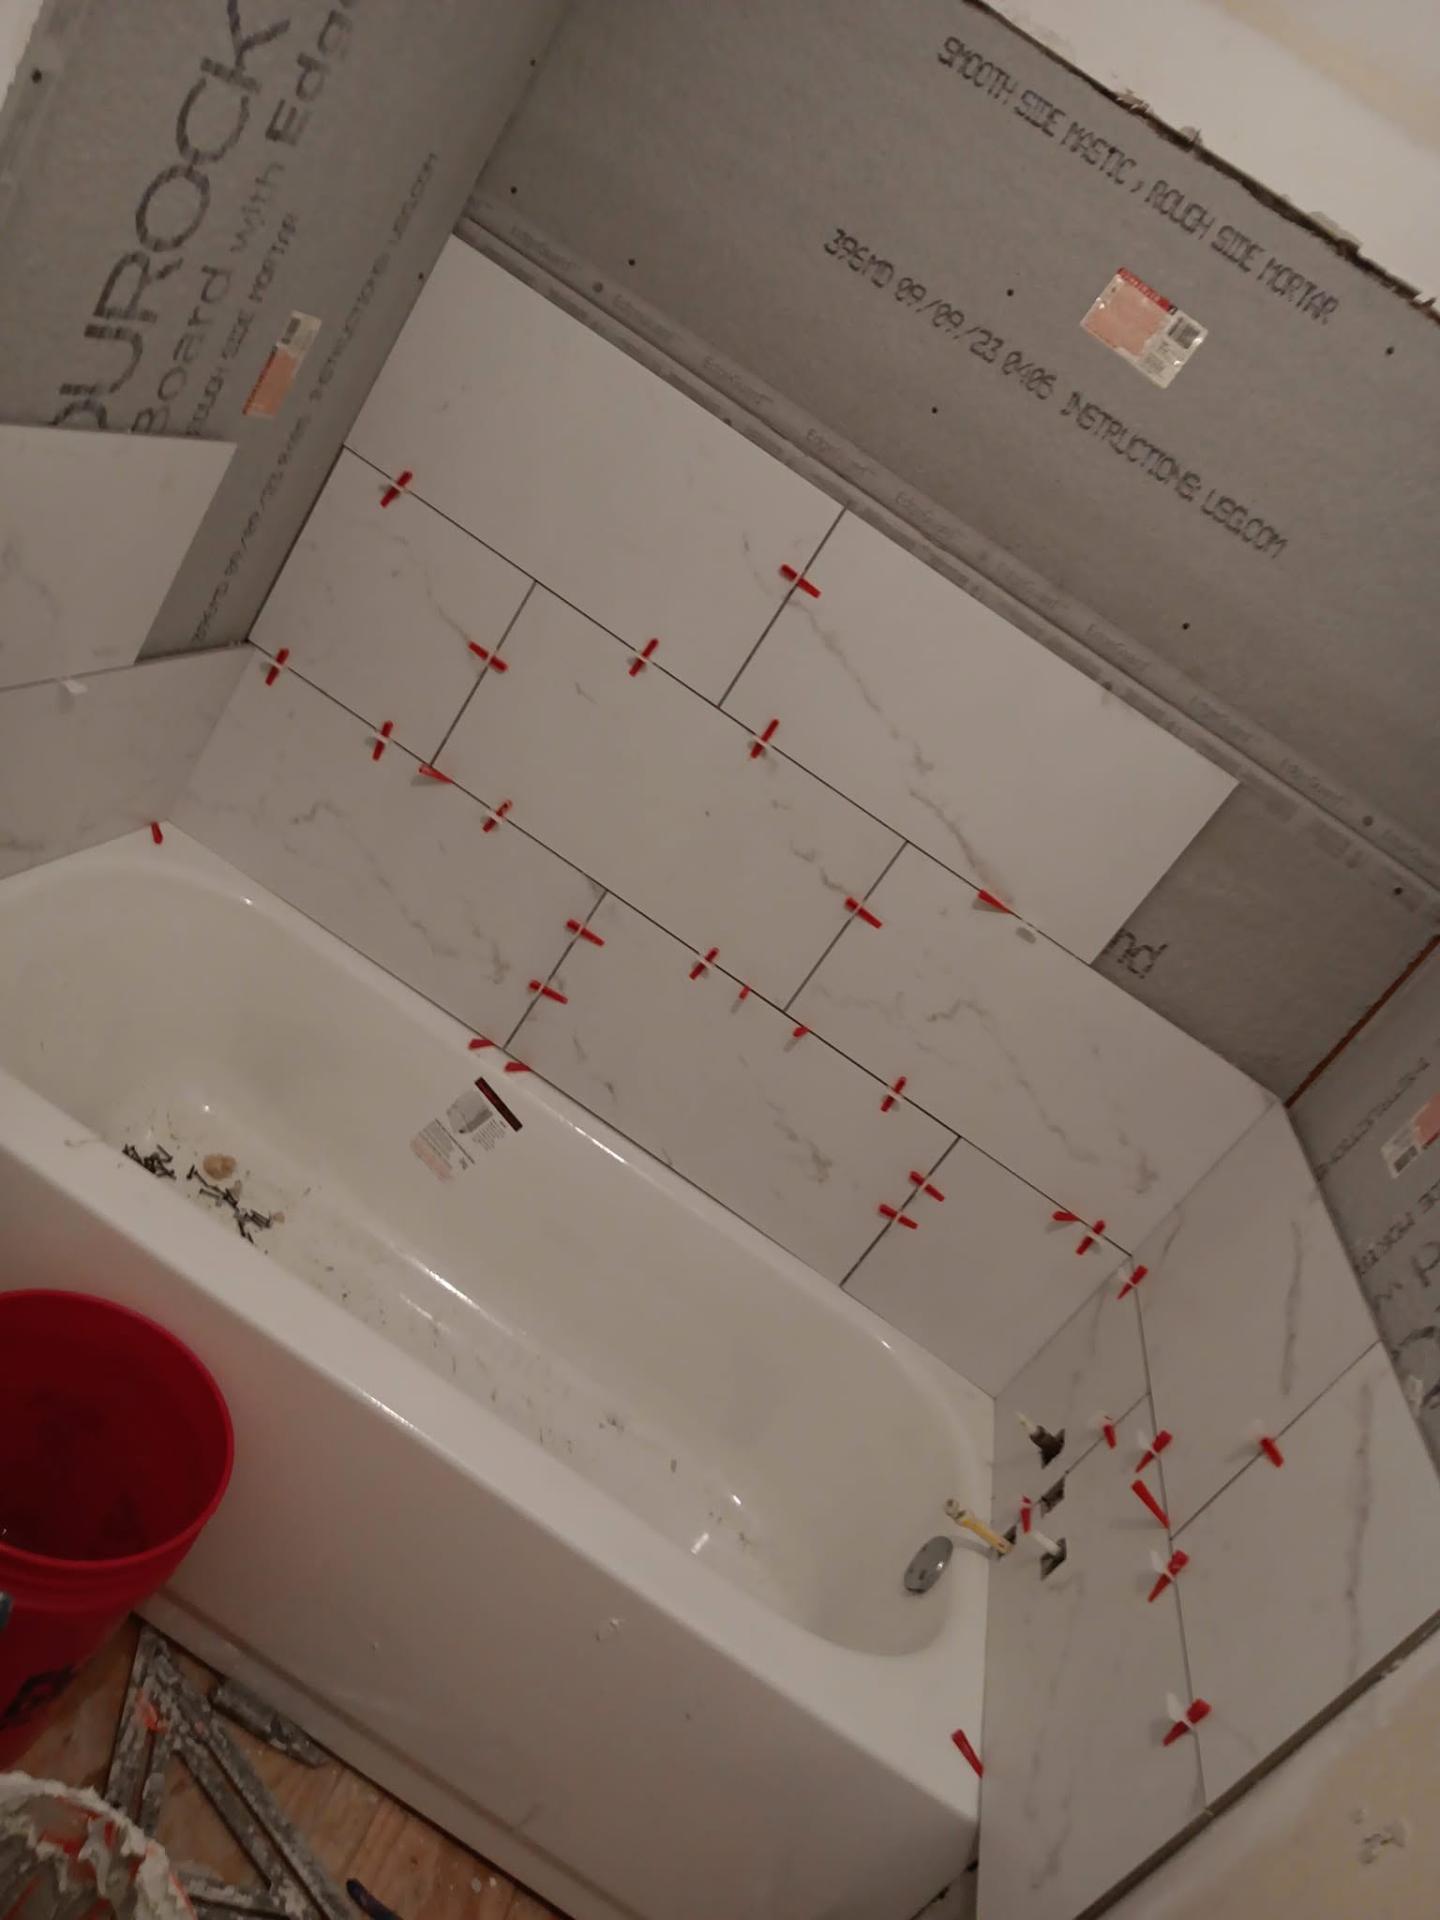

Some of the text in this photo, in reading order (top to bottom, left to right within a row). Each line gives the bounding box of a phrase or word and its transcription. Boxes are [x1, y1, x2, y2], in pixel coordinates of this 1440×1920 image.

[130, 262, 242, 434] Board
[230, 162, 286, 252] with
[221, 308, 256, 361] SIDE
[249, 211, 298, 304] MORTAR
[937, 35, 1015, 105] SMOOTH
[1013, 89, 1066, 138] SIDE
[1060, 121, 1139, 186] MASTIC
[1145, 178, 1217, 242] ROUGH
[1211, 224, 1266, 275] SIDE
[1257, 254, 1341, 327] MORTAR
[895, 277, 1005, 364] 09/09/23
[1201, 488, 1288, 560] USG.COM
